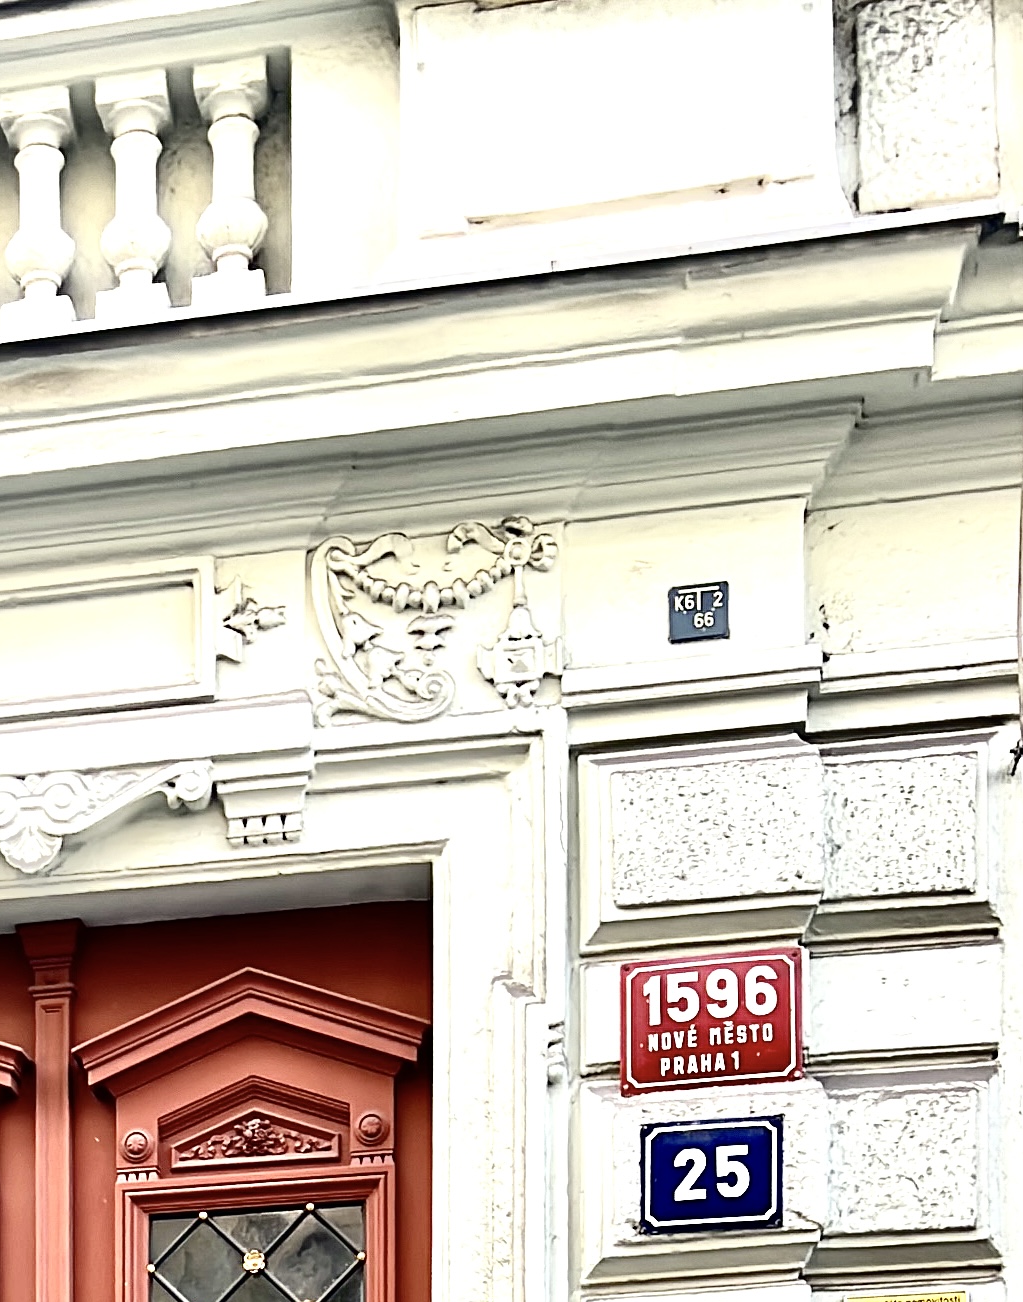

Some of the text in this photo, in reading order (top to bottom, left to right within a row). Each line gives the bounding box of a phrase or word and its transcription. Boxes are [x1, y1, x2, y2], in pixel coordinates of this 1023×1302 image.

[642, 965, 778, 1027] 1596
[647, 1020, 774, 1052] NOVÉ MĚSTO
[660, 1050, 740, 1077] PRAHA 1
[673, 1144, 751, 1202] 25
